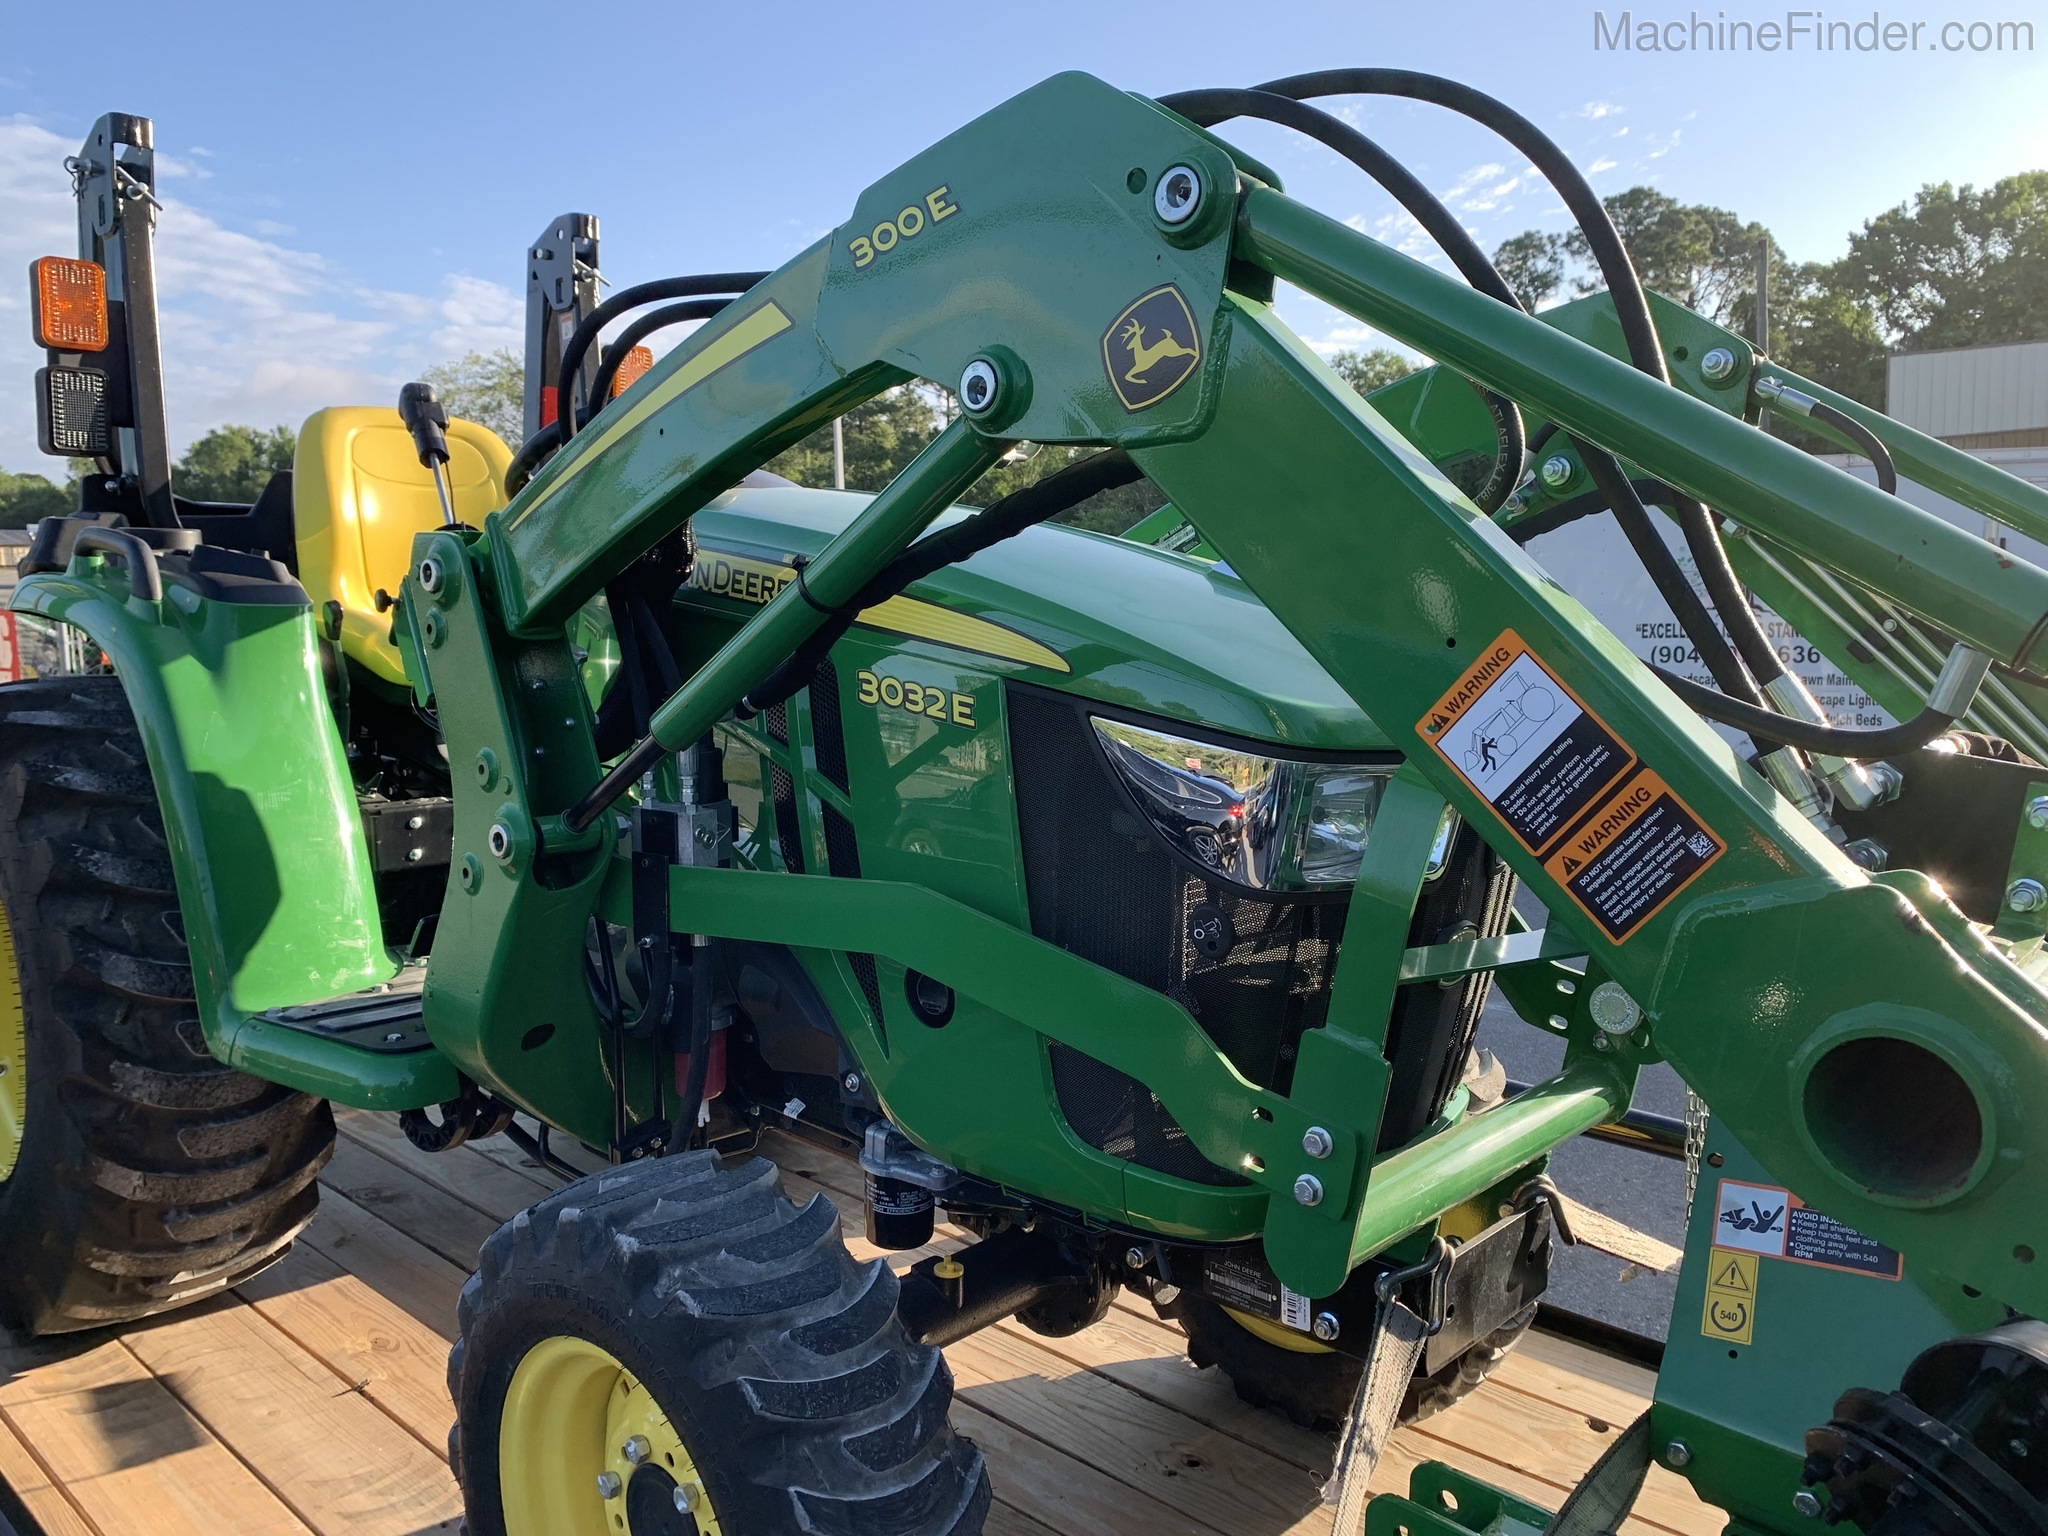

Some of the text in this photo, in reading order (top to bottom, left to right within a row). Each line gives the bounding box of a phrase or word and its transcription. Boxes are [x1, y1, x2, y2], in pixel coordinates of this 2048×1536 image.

[1651, 645, 1706, 668] (904
[1777, 645, 1821, 664] 636
[1444, 647, 1511, 715] WARNING
[1801, 675, 1823, 686] awn
[1855, 713, 1883, 727] Beds
[1509, 785, 1525, 801] avoid
[1525, 769, 1541, 786] injury
[1540, 757, 1555, 770] from
[1553, 737, 1574, 757] falling
[1518, 755, 1581, 817] Do not walk or perform
[1524, 802, 1545, 822] service
[1544, 785, 1562, 803] under
[1565, 763, 1584, 783] raised
[1583, 745, 1605, 764] loader.
[1529, 751, 1610, 830] Lower loader to ground when
[1507, 794, 1528, 814] loader:
[1536, 815, 1559, 837] parked.
[1578, 787, 1652, 855] WARNING
[1579, 807, 1665, 886] DO NOT operate loader without
[1586, 825, 1660, 893] engaging attachment latch.
[1595, 824, 1682, 905] Failure to engage retainer could
[1602, 893, 1620, 911] result
[1618, 888, 1626, 896] in
[1624, 860, 1657, 892] attachment
[1656, 835, 1686, 863] detaching
[1608, 904, 1624, 918] from
[1621, 887, 1641, 906] loader
[1640, 867, 1664, 890] causing
[1662, 848, 1685, 870] serious
[1614, 871, 1675, 925] bodily injury or death.
[1792, 1211, 1843, 1225] AVOID INJU
[1798, 1219, 1817, 1229] Keep
[1796, 1235, 1848, 1250] clothing away
[1797, 1227, 1877, 1247] Keep hands, feet and
[1795, 1242, 1878, 1263] Operate only with 540
[1795, 1250, 1813, 1259] RPM
[1223, 1260, 1240, 1271] JOHN
[1242, 1266, 1261, 1278] DEERE
[1720, 1310, 1737, 1322] 540
